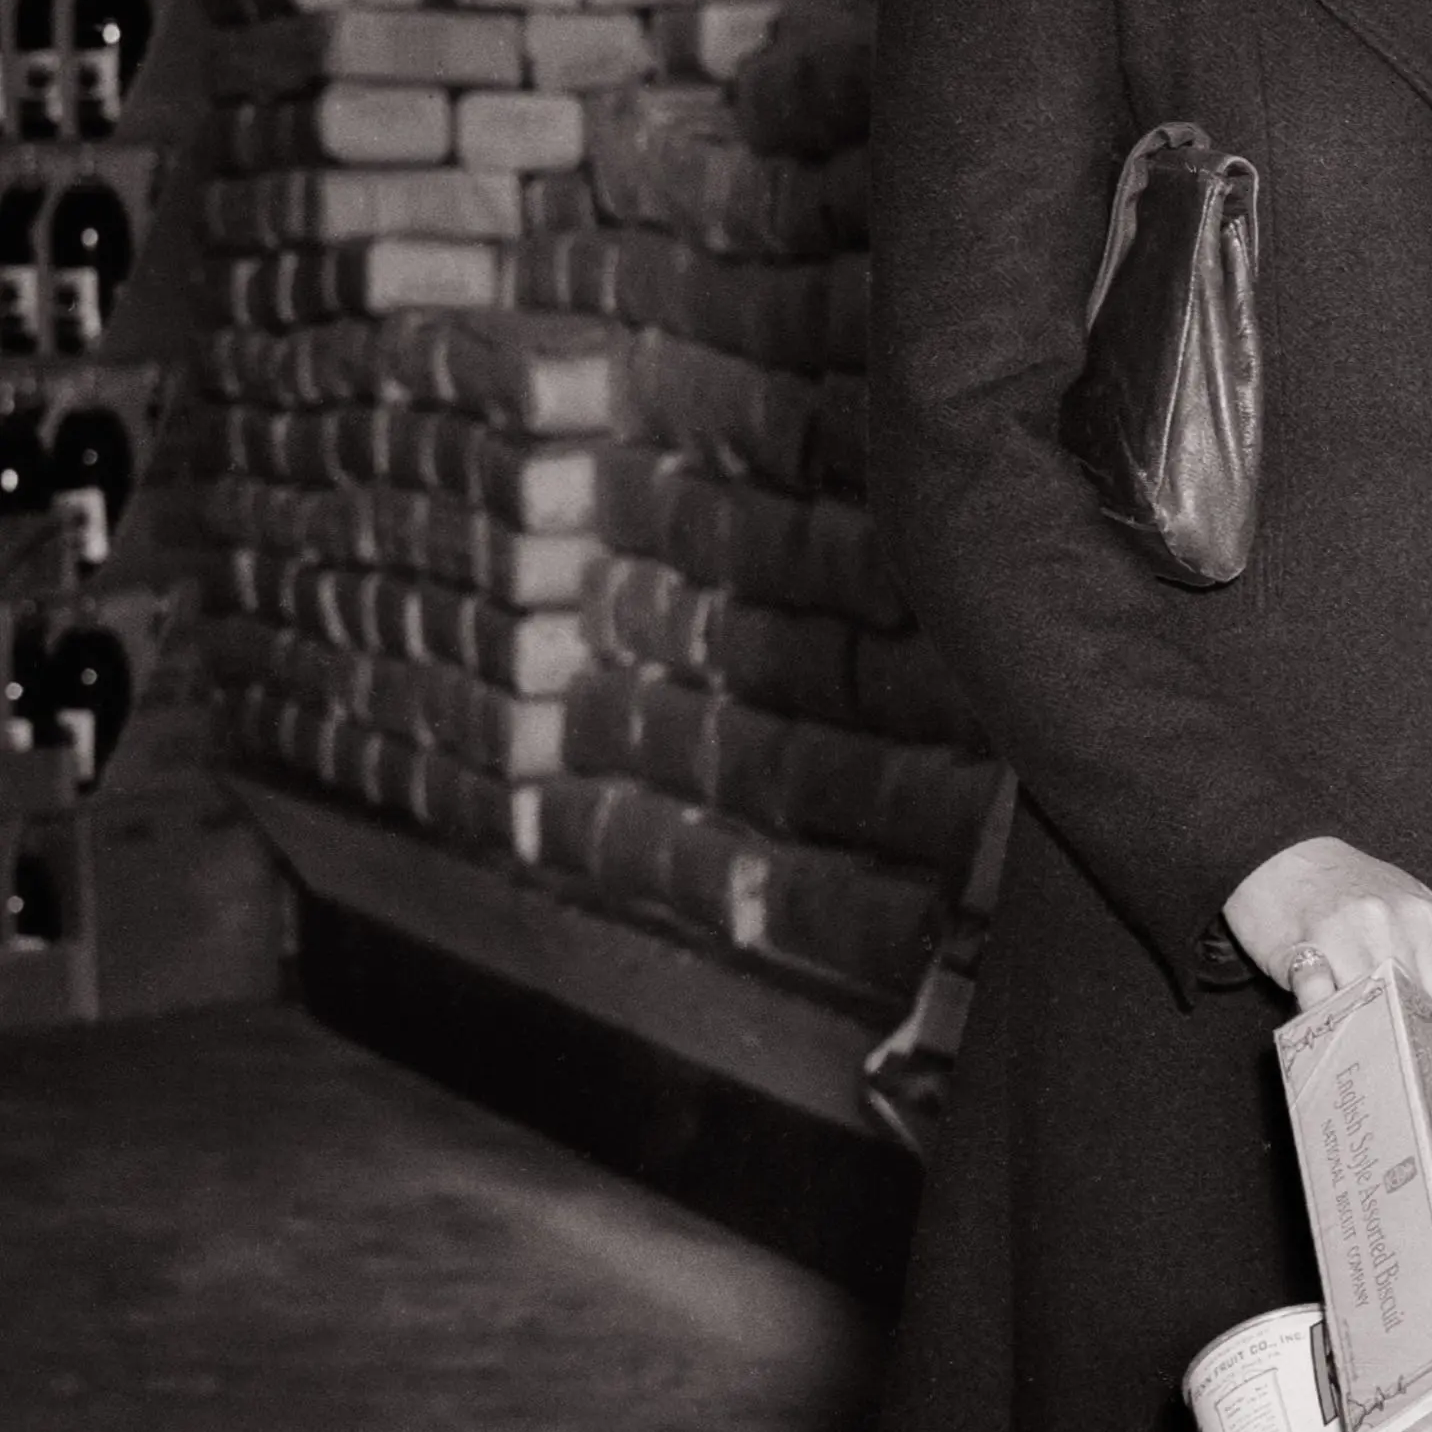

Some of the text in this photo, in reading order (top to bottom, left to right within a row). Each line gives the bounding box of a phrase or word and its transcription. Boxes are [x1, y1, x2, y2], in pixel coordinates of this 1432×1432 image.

[1334, 1062, 1370, 1137] English
[1321, 1118, 1371, 1309] NATIONAL BISCUIT COMPANY
